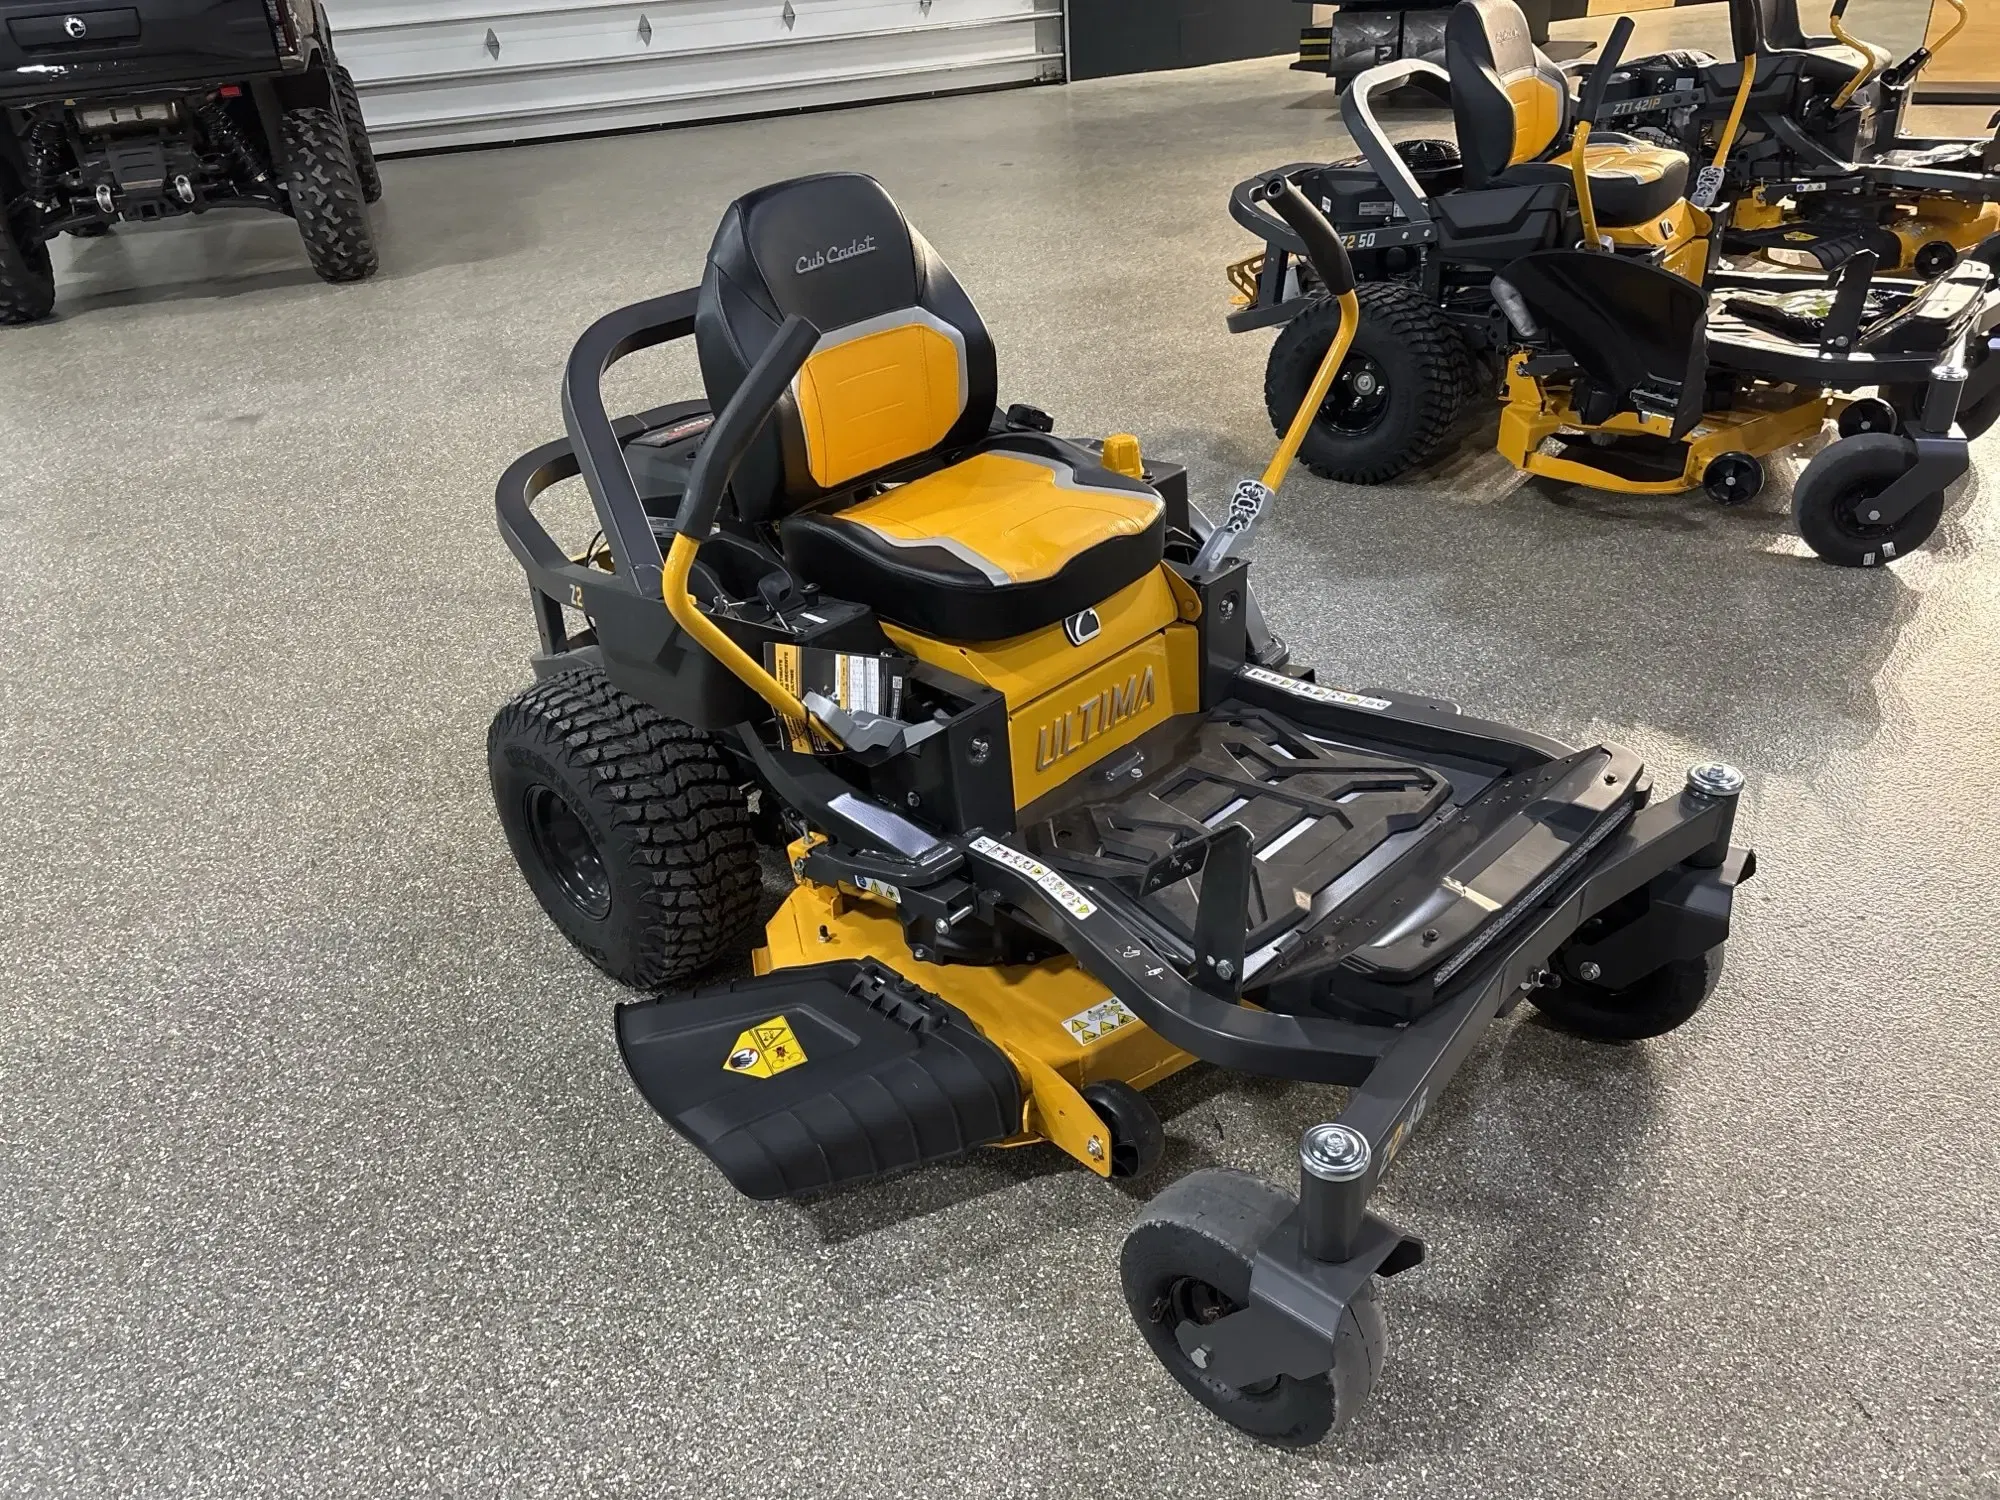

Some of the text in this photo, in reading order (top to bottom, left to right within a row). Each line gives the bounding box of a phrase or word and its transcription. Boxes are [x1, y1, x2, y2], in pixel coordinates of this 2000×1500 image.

[795, 234, 876, 274] Cub Cadet
[1341, 232, 1376, 250] Z2 50
[569, 584, 583, 608] Z2
[1036, 665, 1155, 772] ULTIMA
